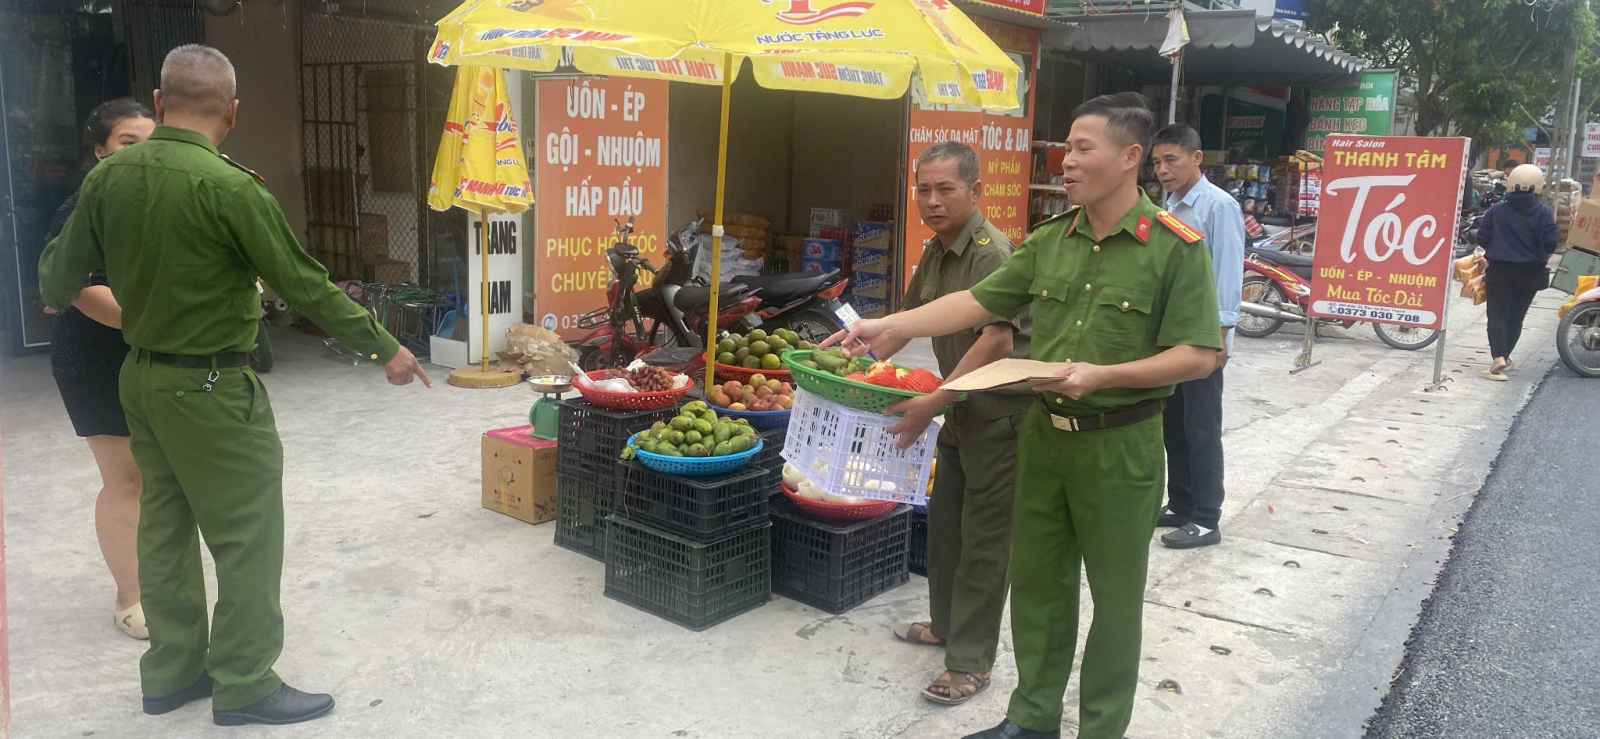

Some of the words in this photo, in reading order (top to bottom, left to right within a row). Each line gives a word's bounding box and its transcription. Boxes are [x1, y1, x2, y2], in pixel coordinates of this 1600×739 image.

[756, 32, 804, 44] NƯỚC
[805, 30, 849, 42] TĂNG
[850, 29, 884, 39] LỰC
[623, 84, 645, 122] ÉP
[1343, 97, 1364, 114] TẠP
[1309, 115, 1341, 131] BÁNH
[1343, 118, 1367, 134] KẸO
[910, 126, 932, 143] CHĂM
[934, 126, 949, 143] SÓC
[963, 128, 980, 147] MẶT
[982, 121, 1002, 150] TÓC
[1005, 128, 1013, 151] &
[1016, 128, 1029, 152] DA
[1307, 135, 1325, 151] BÌN
[1332, 139, 1354, 147] Hair
[1355, 140, 1386, 148] Salon
[546, 127, 579, 172] GỘI
[597, 131, 661, 173] NHUỘM
[1334, 151, 1399, 169] THANH
[1405, 150, 1447, 170] TÂM
[565, 175, 603, 217] HẤP
[608, 176, 643, 217] DẦU
[984, 183, 1005, 197] CHĂM
[1006, 183, 1022, 197] SÓC
[1007, 206, 1017, 218] DA
[1325, 174, 1446, 266] Tóc
[546, 236, 592, 261] PHỤC
[810, 244, 821, 255] 3A
[551, 265, 613, 293] CHUYÊ
[1320, 265, 1345, 279] UỐN
[1357, 268, 1373, 281] ÉP
[1389, 273, 1437, 288] NHUỘM
[1326, 283, 1362, 301] Mua
[1366, 287, 1391, 303] Tóc
[1394, 290, 1424, 307] Dài
[1337, 307, 1367, 317] 0373
[1370, 311, 1393, 320] 030
[1396, 313, 1420, 322] 708
